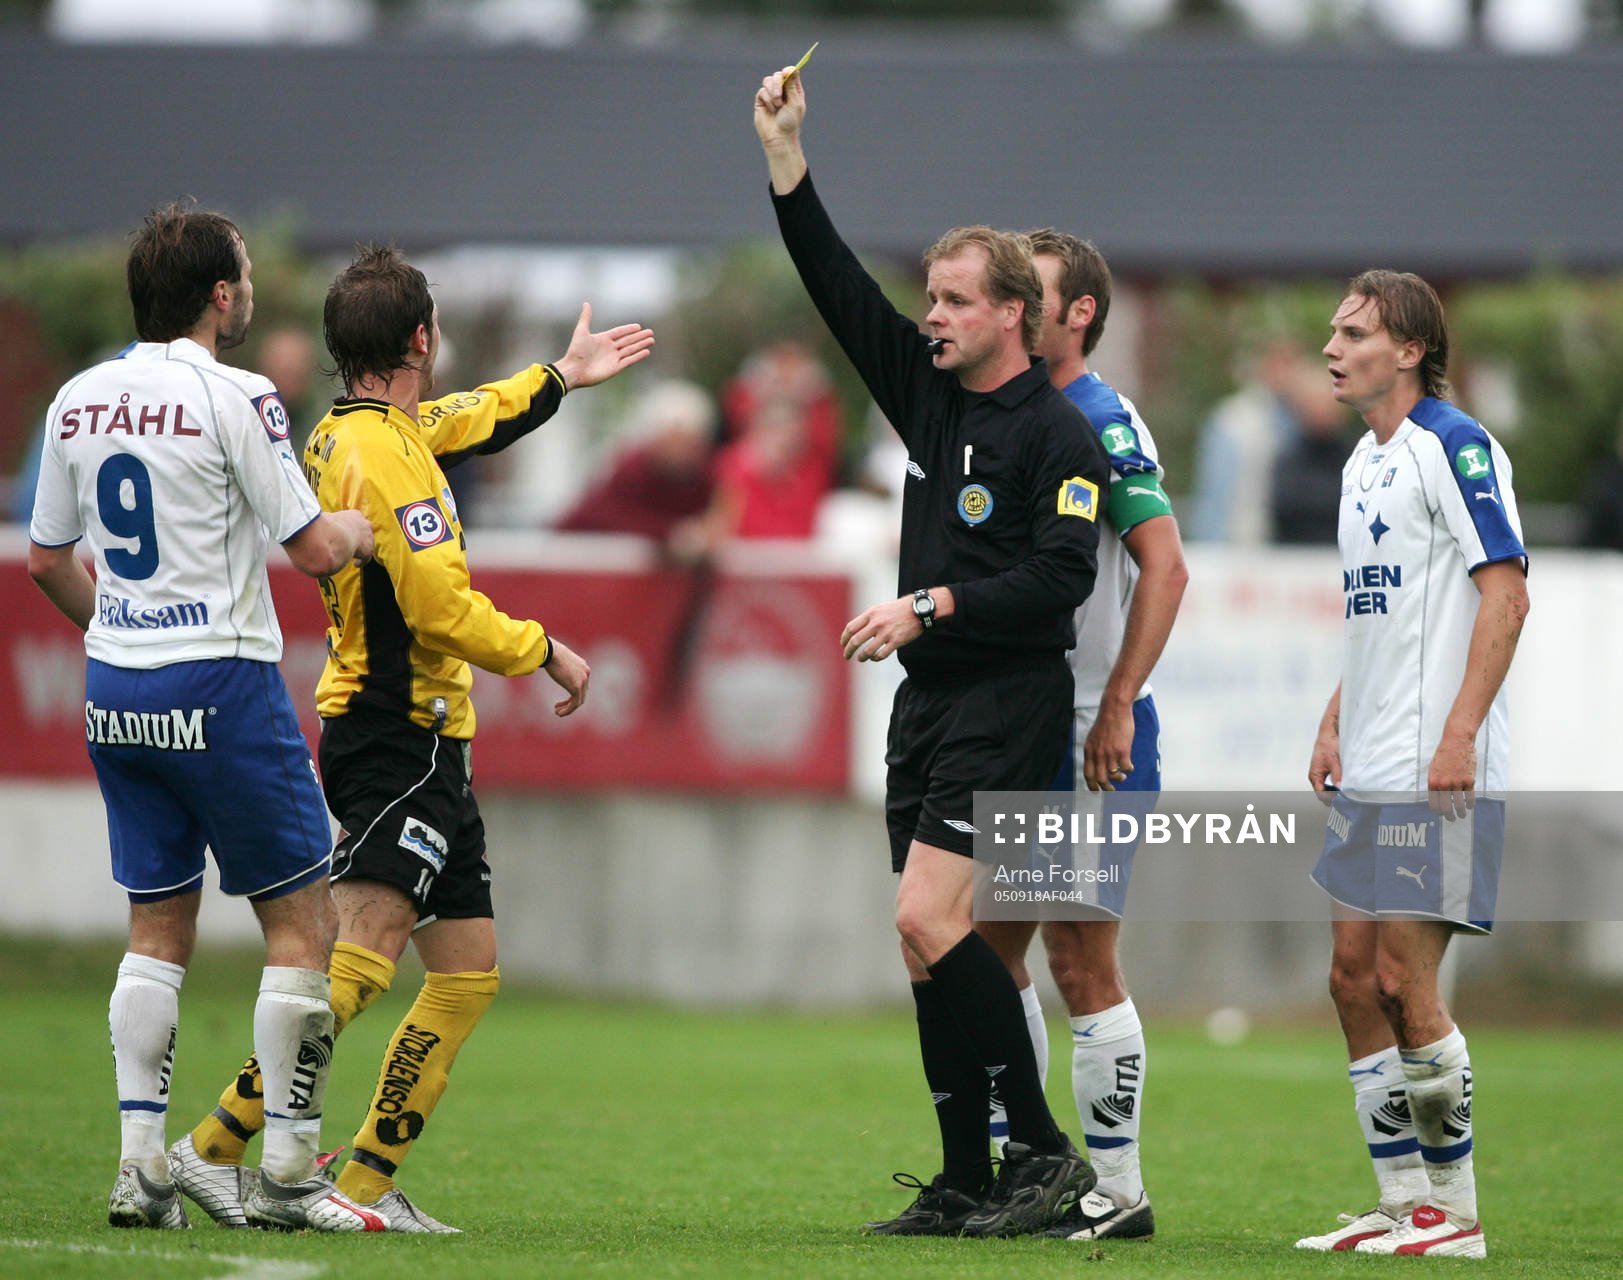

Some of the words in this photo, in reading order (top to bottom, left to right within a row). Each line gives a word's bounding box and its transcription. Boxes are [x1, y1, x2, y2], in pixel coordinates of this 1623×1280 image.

[60, 392, 202, 440] STÅHL
[265, 405, 286, 428] 13
[96, 452, 160, 581] 9
[410, 512, 438, 537] 13
[85, 700, 207, 750] STADIUM
[287, 1042, 321, 1110] SITA
[1113, 1053, 1141, 1115] SITA
